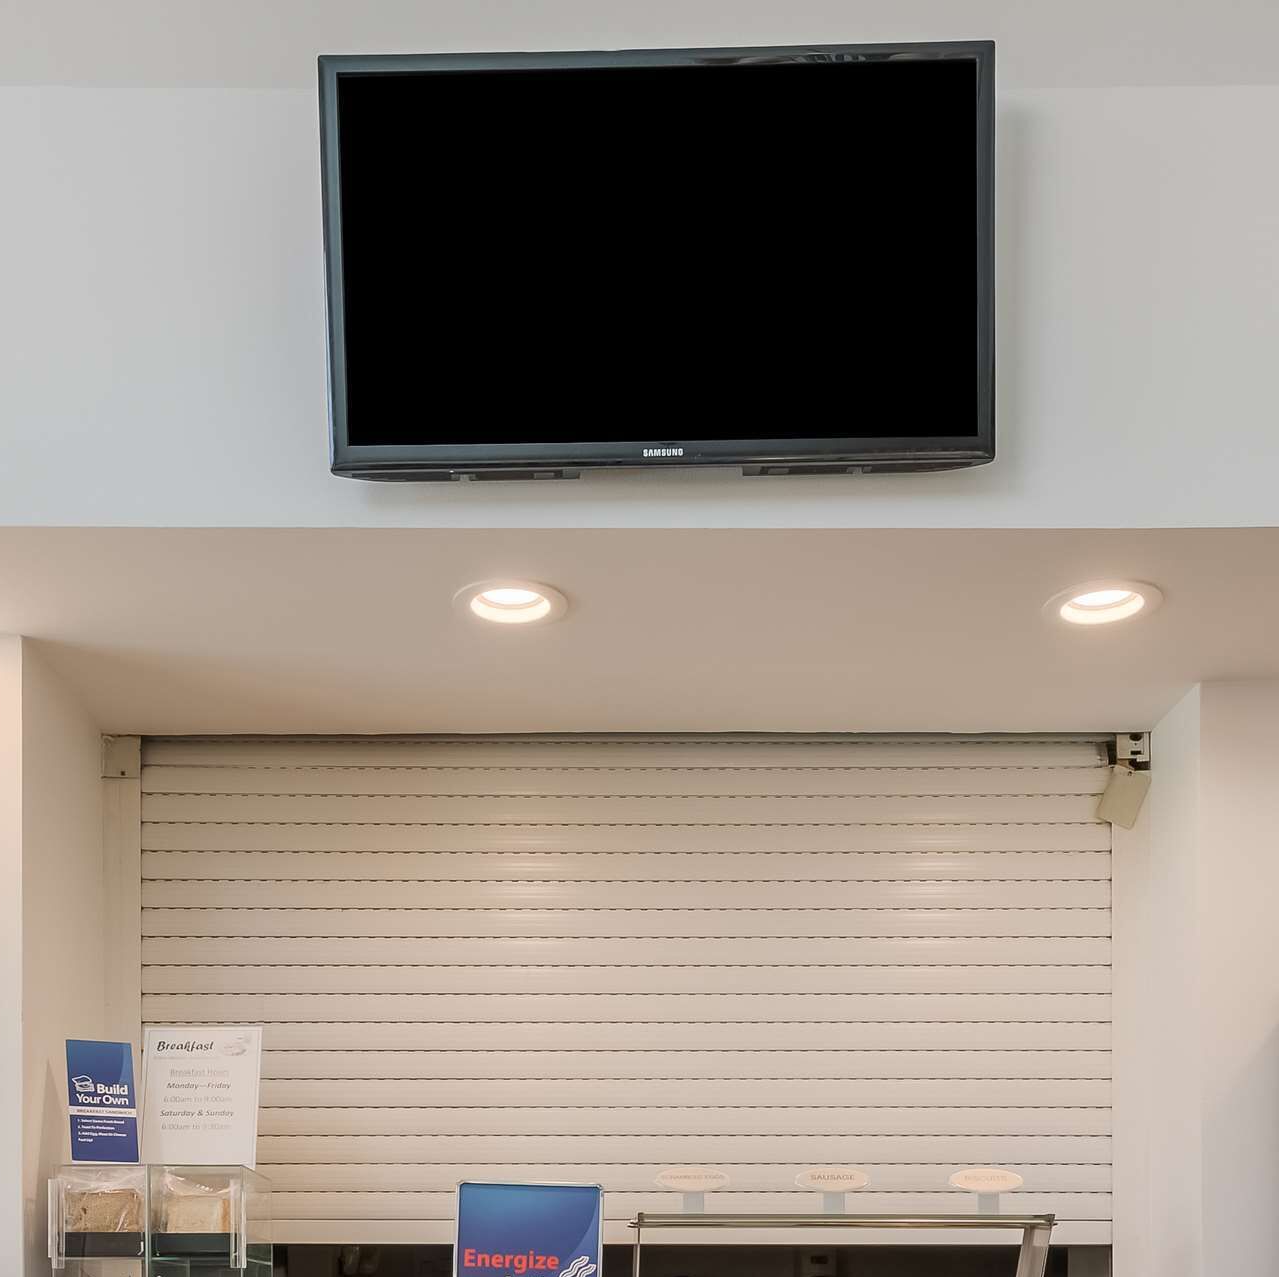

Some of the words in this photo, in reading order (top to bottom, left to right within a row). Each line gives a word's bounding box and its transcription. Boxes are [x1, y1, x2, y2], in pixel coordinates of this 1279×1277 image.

[643, 448, 684, 457] SAMSUNG
[157, 1040, 214, 1052] Breakfast
[96, 1083, 128, 1095] Build
[76, 1093, 101, 1105] Your
[102, 1094, 129, 1105] Own
[160, 1110, 195, 1119] Saturday
[205, 1110, 234, 1118] Sunday
[463, 1247, 560, 1275] Energize
